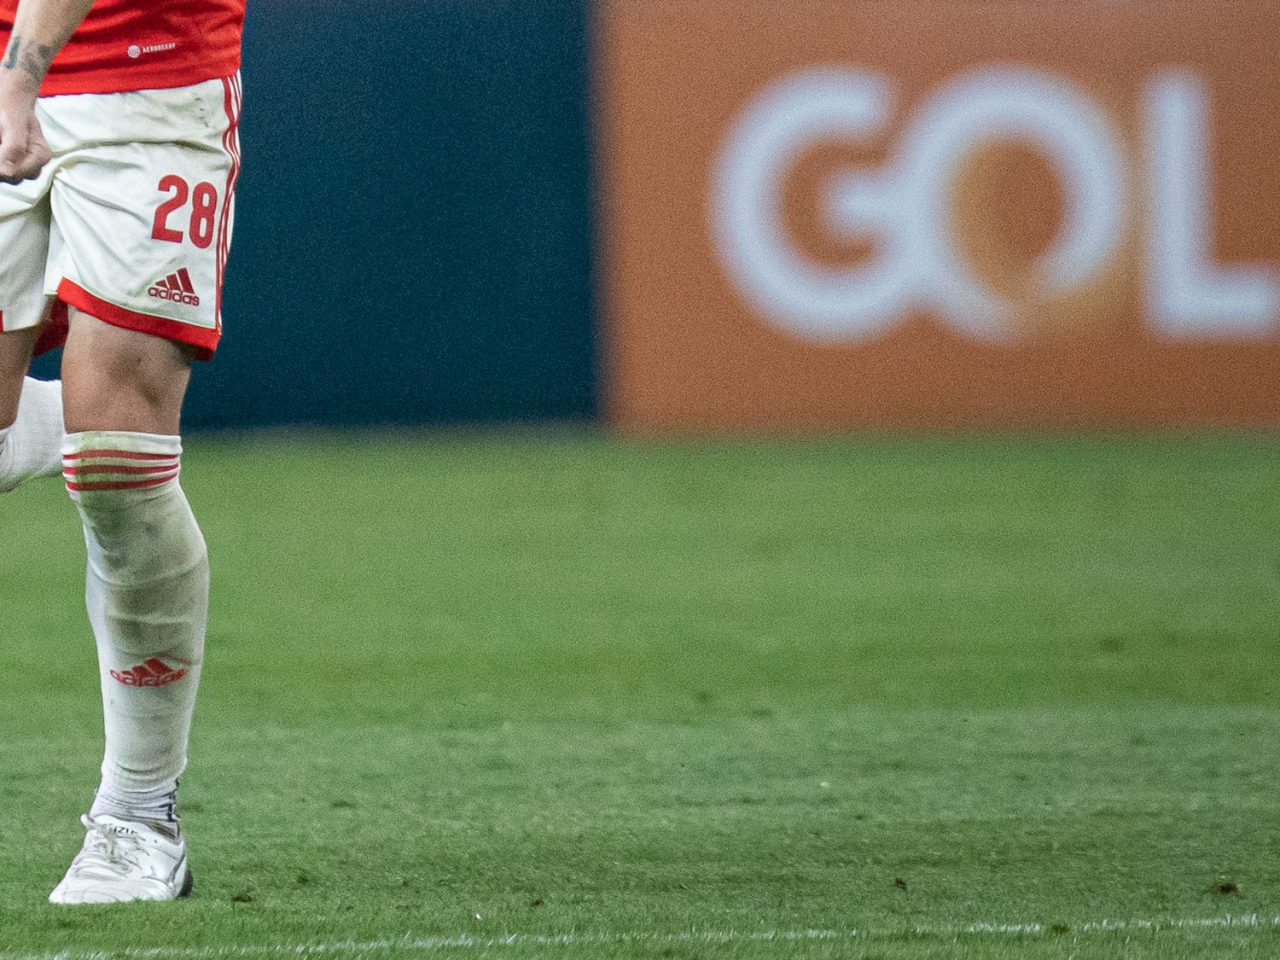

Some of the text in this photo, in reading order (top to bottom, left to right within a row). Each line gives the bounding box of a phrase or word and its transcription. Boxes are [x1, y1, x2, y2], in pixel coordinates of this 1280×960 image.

[151, 174, 218, 249] 28
[712, 66, 1280, 343] GOL
[148, 287, 200, 307] adidas
